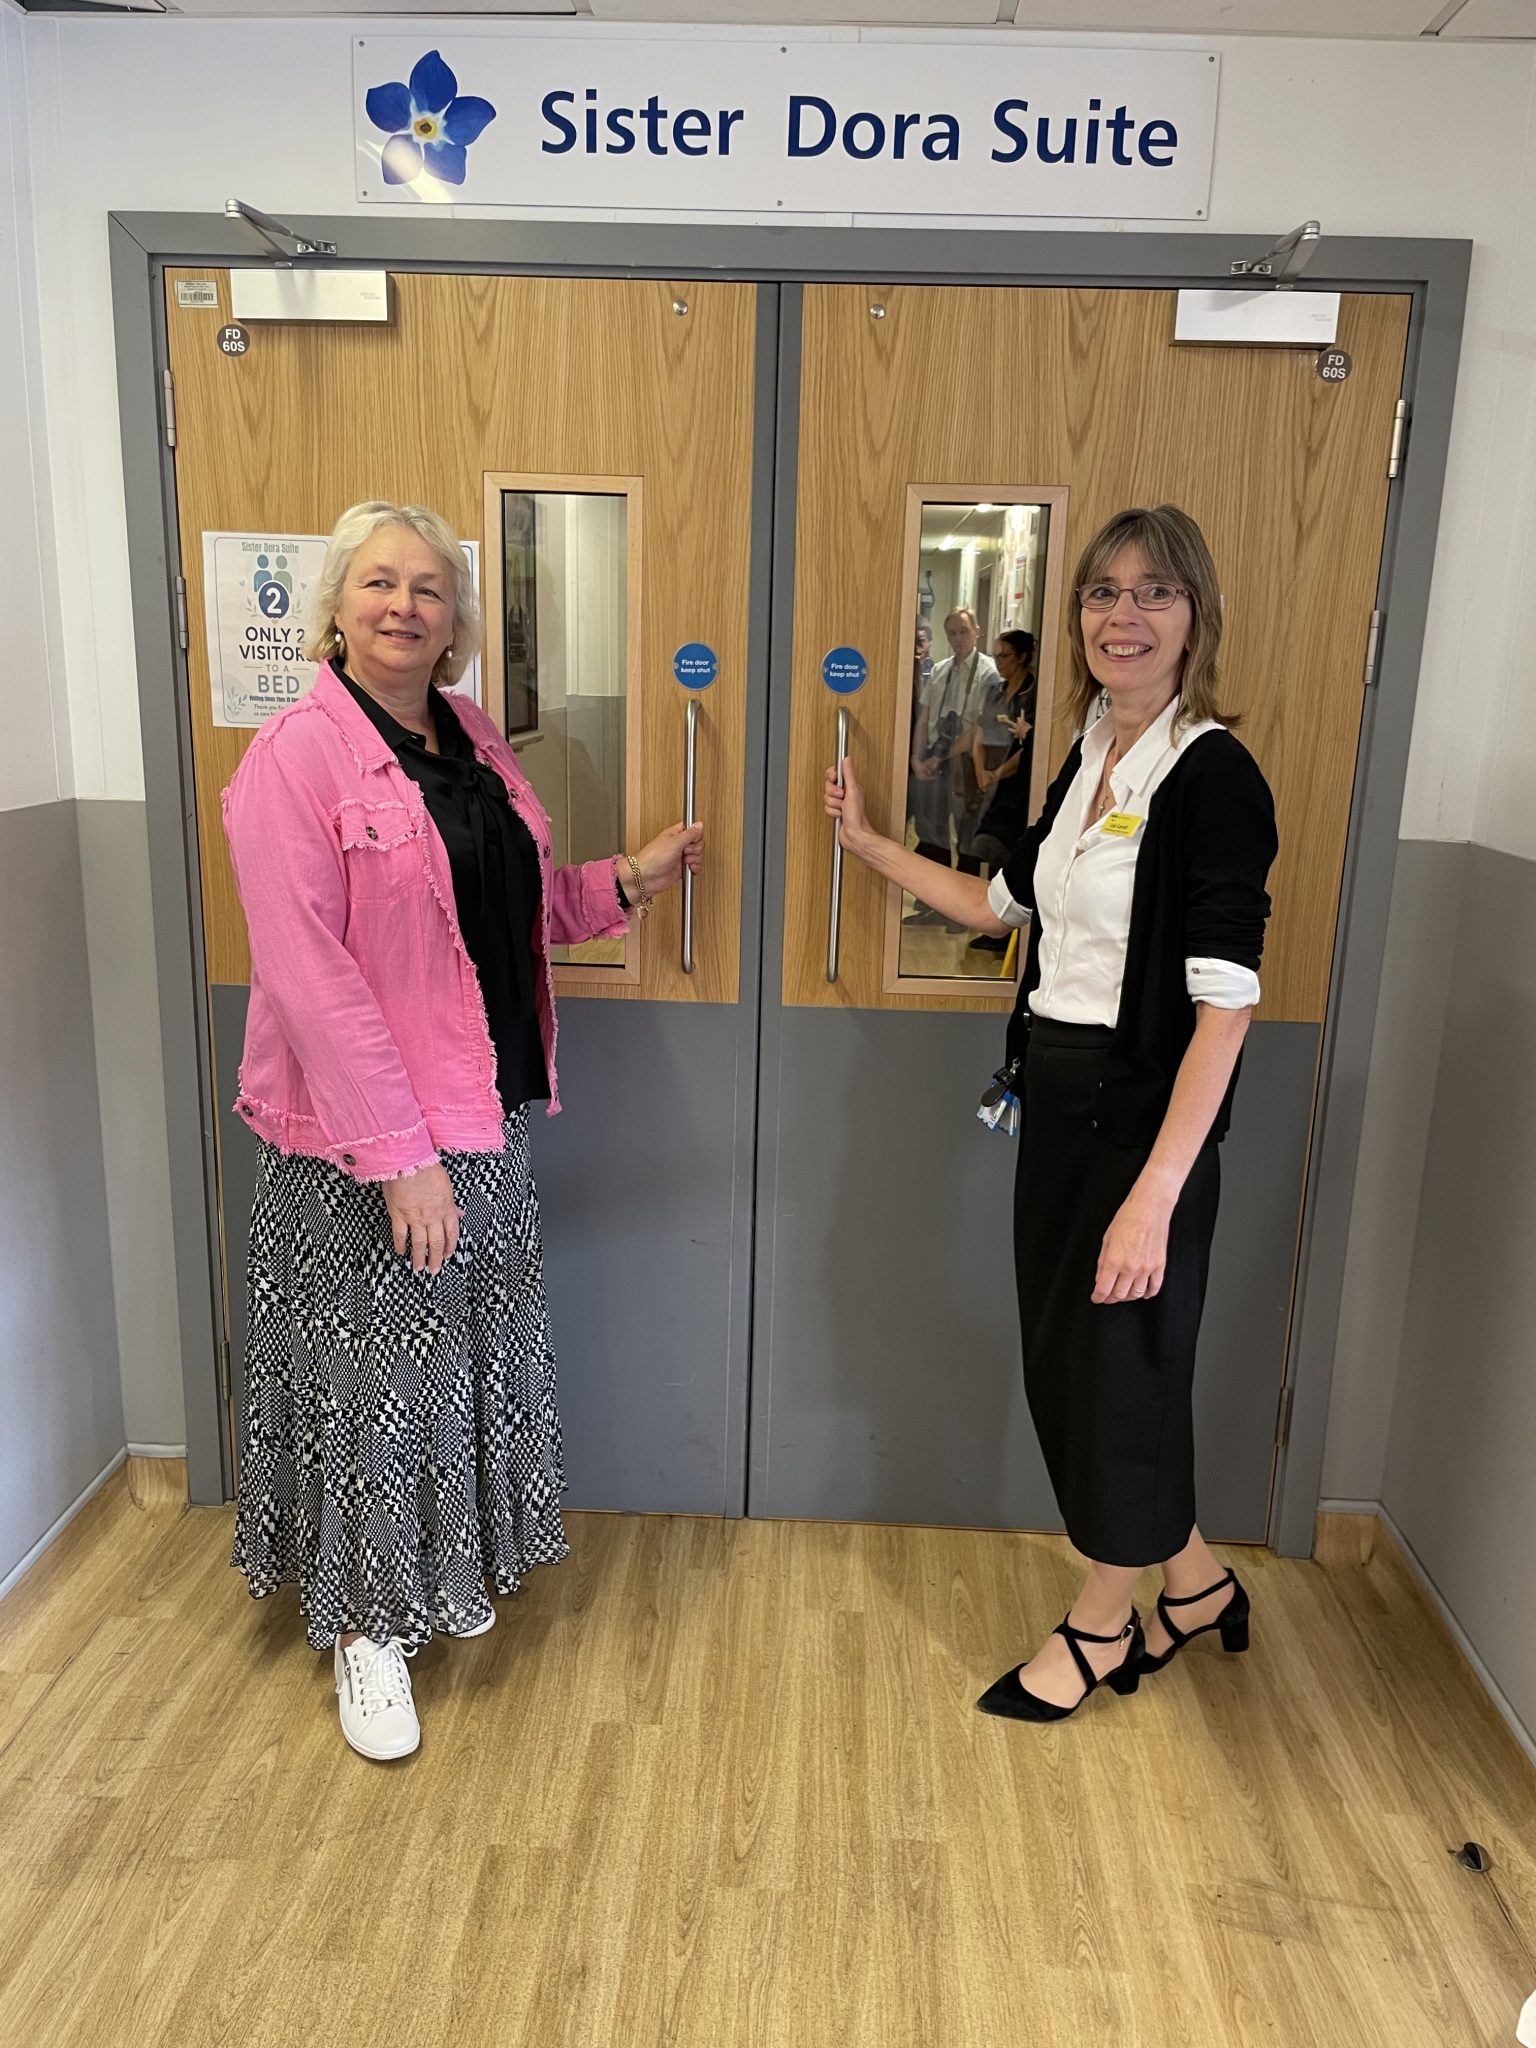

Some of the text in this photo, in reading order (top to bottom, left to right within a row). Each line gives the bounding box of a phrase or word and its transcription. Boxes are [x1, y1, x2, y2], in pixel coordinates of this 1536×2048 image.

[540, 88, 1180, 167] Sister Dora Suite
[225, 328, 241, 340] FD
[222, 341, 246, 352] 60S
[1327, 354, 1345, 366] FD
[1322, 367, 1347, 379] 60S
[241, 541, 300, 554] Sister Dora Suite
[266, 587, 282, 614] 2
[245, 626, 306, 644] ONLY 2
[239, 645, 313, 662] VISITOR
[266, 664, 290, 673] TO A
[257, 674, 300, 694] BED
